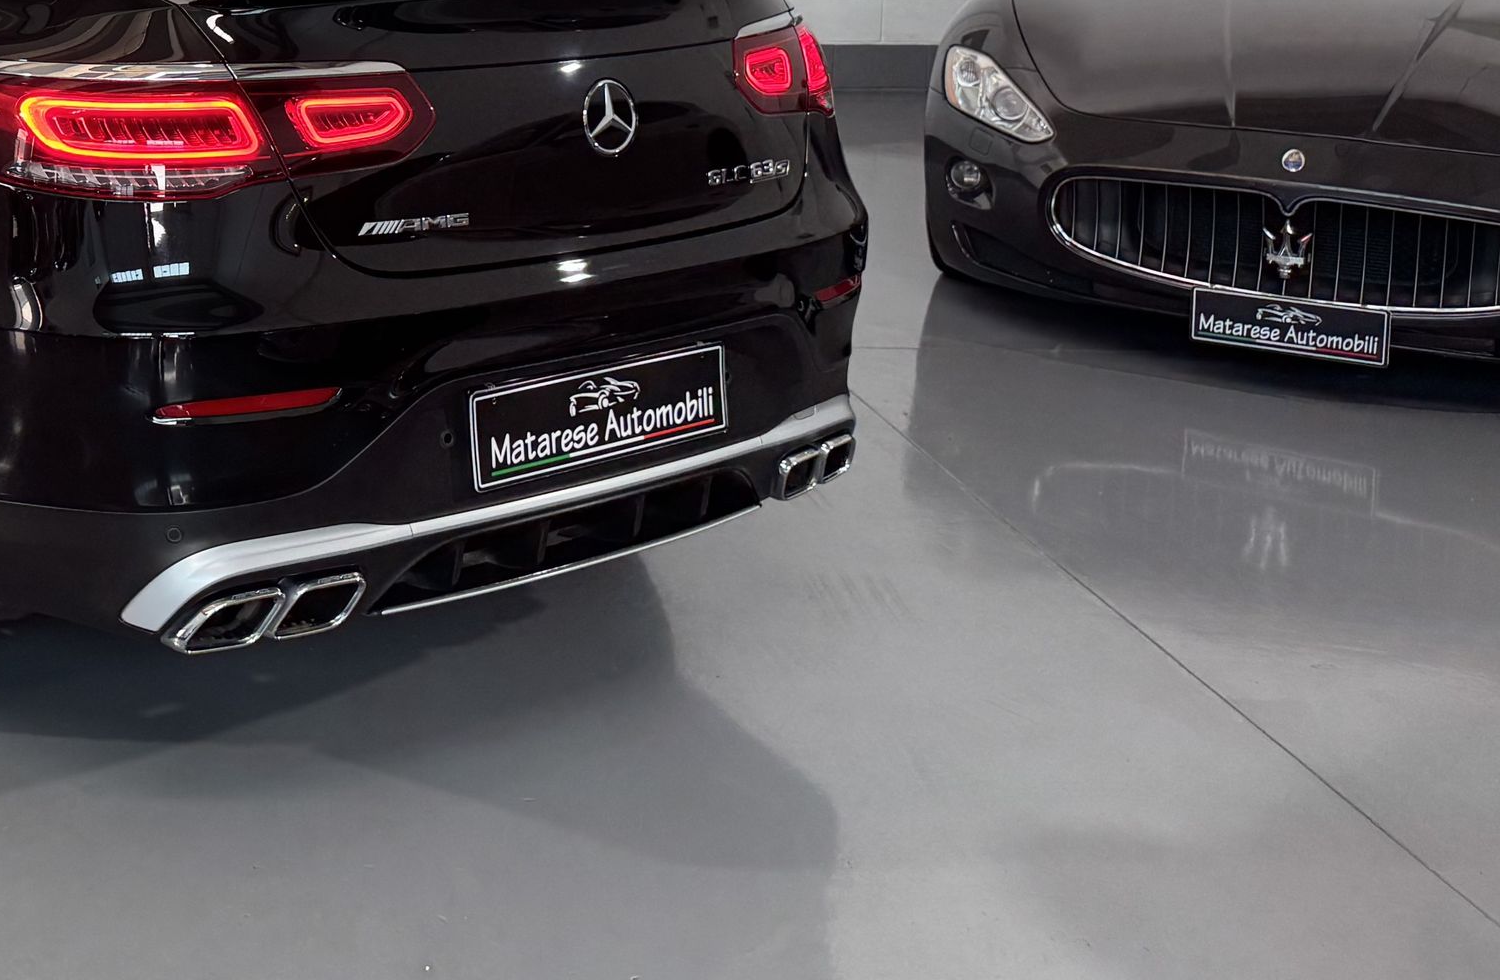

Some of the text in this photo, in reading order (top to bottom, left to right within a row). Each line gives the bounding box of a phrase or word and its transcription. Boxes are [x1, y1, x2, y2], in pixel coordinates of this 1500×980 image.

[707, 165, 747, 186] GLC
[1198, 312, 1379, 355] Matarese Automobili
[490, 386, 715, 469] Matarese Automobili
